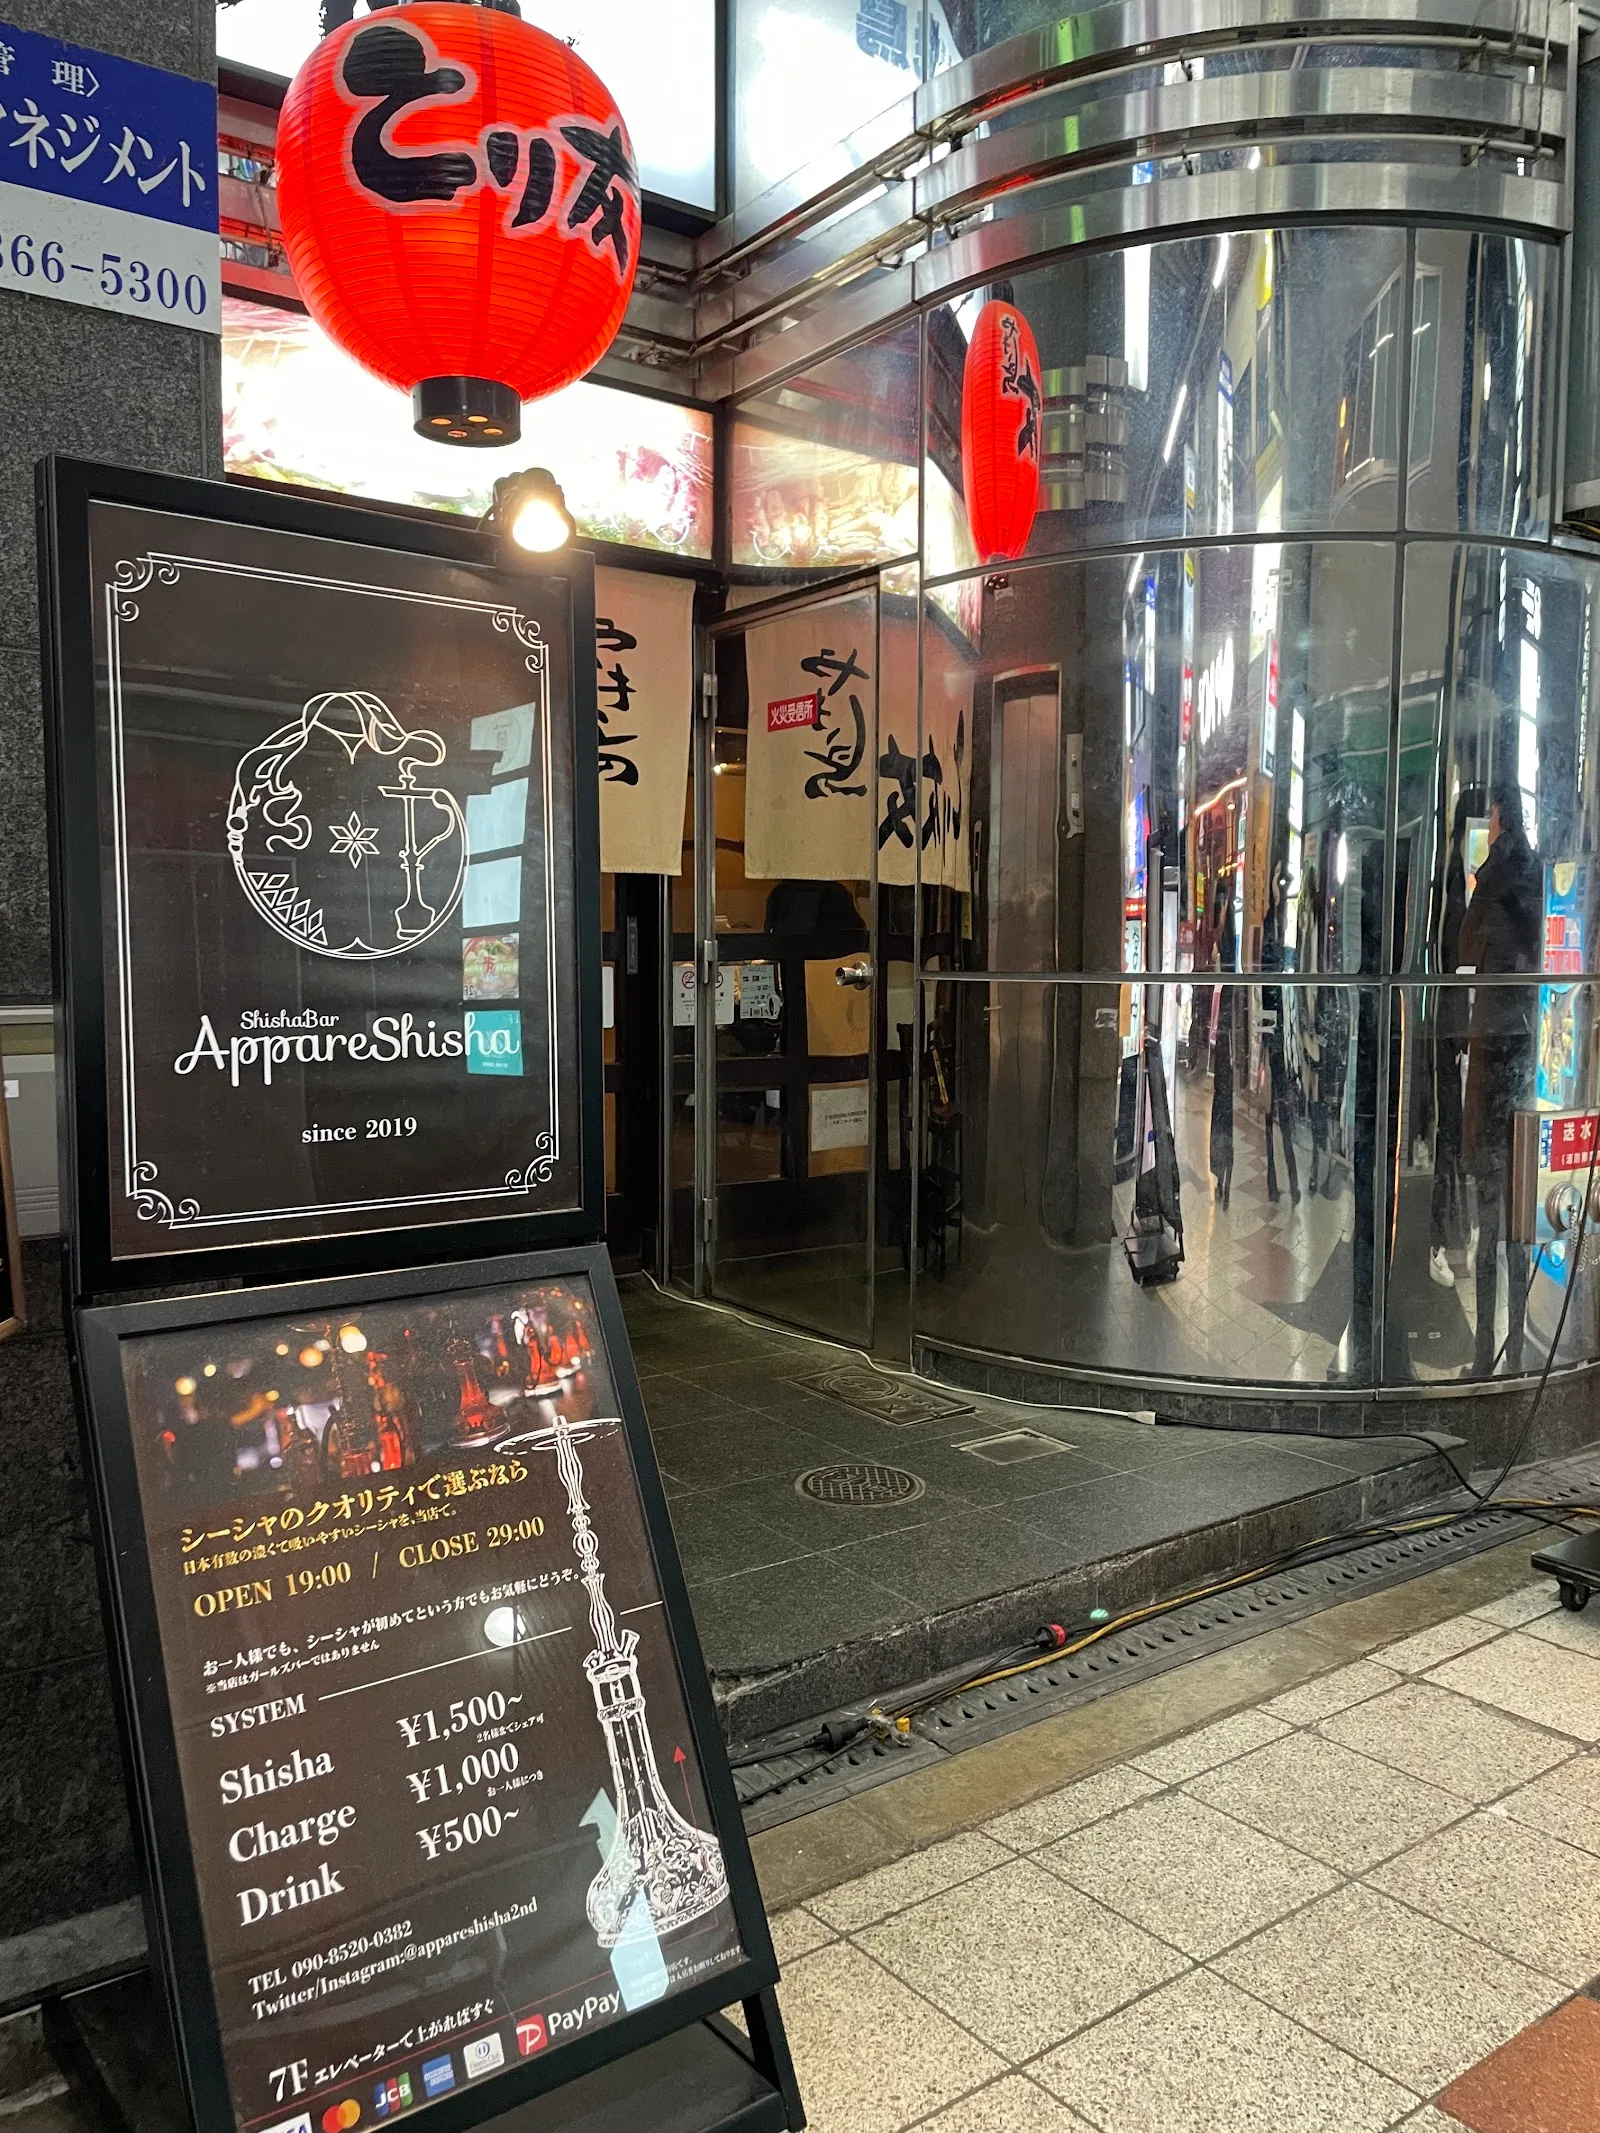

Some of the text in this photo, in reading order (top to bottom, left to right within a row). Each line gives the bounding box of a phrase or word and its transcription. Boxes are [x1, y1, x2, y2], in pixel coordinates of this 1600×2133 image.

[0, 97, 207, 208] ネジメント
[0, 234, 207, 315] 66-5300
[770, 698, 814, 727] 火災受信所
[173, 1011, 522, 1088] AppareShisha
[301, 1115, 418, 1144] since 2019
[181, 1460, 529, 1553] シーシャのクオリティで選ぶなら
[193, 1578, 273, 1618] OPEN
[286, 1561, 352, 1597] 19:00
[399, 1531, 479, 1569] CLOSE
[486, 1516, 545, 1548] 29:00
[210, 1693, 307, 1738] SYSTEM
[219, 1749, 335, 1805] Shisha
[229, 1742, 520, 1863] Charge ¥1,000
[236, 1862, 346, 1926] Drink
[248, 1920, 413, 1995] TEL 090-8520-0382
[548, 1990, 620, 2036] PayPay
[268, 2058, 310, 2102] 7F
[375, 2083, 411, 2108] JCB
